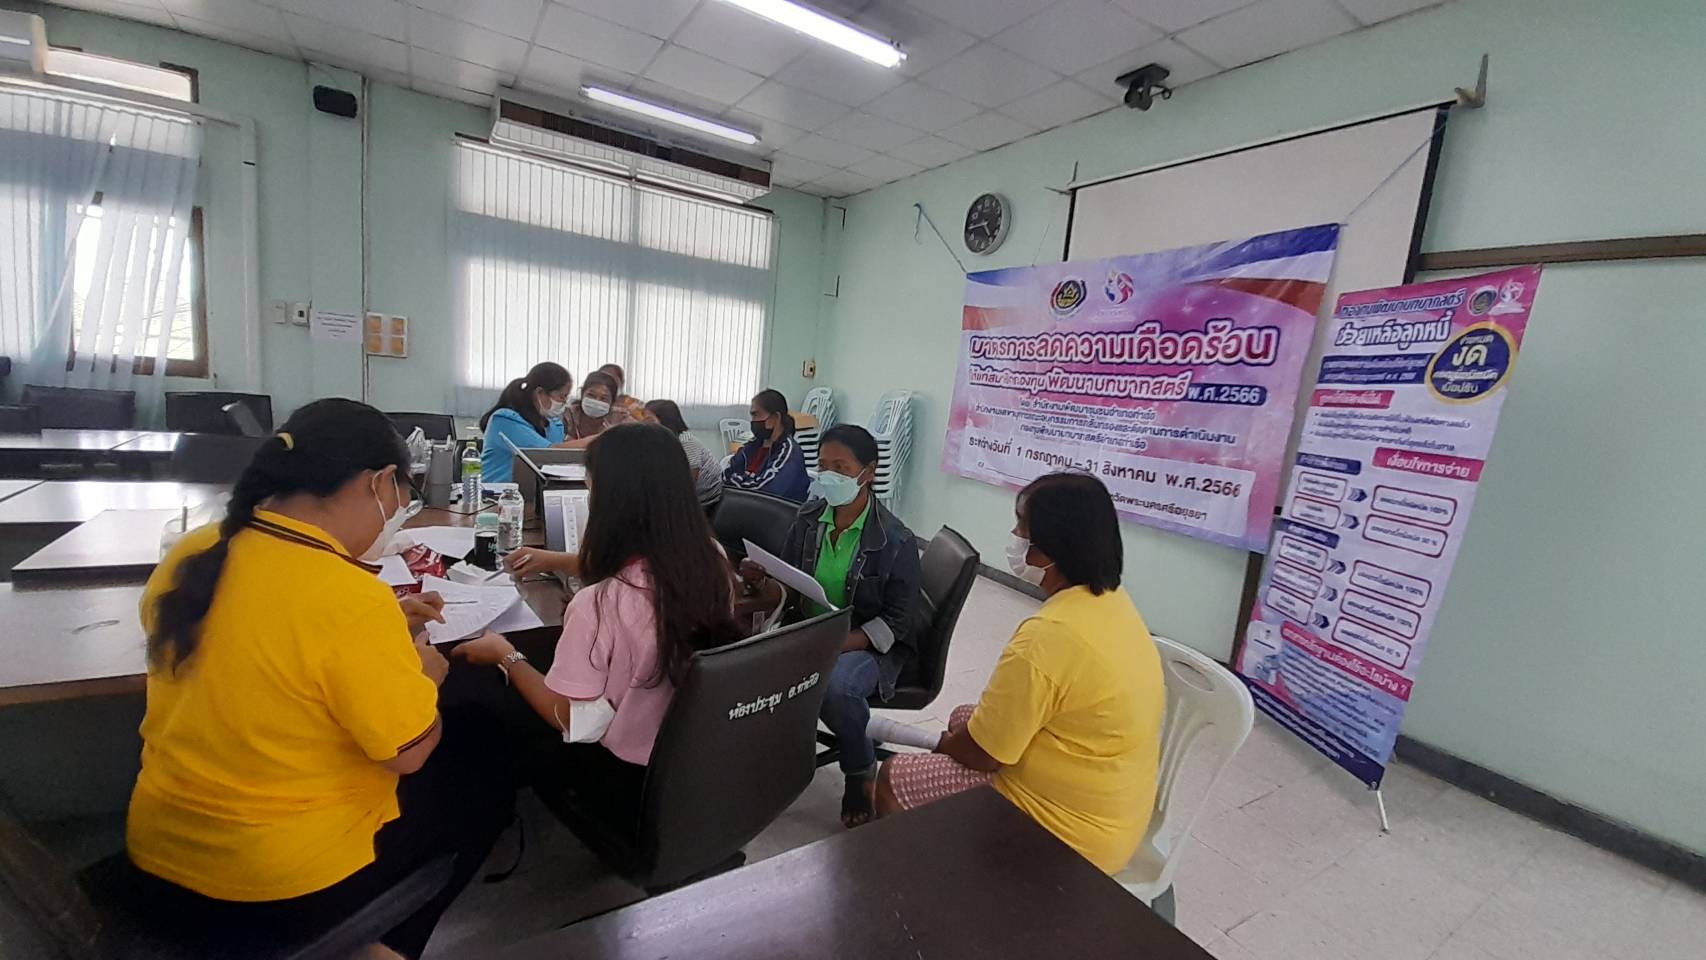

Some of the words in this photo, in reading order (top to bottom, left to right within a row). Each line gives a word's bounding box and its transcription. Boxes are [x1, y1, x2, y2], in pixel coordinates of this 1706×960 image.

[970, 321, 1276, 362] มาตรการลดความเดือดร้อน
[1335, 311, 1455, 350] ช่วยเหลือลูกหนี้
[1452, 344, 1488, 367] งด
[1188, 385, 1260, 404] พ.ศ.2566
[969, 436, 1013, 455] ระหว่างวันที่
[1016, 446, 1022, 457] 1
[1025, 448, 1073, 467] กรกฎาคม
[1086, 459, 1098, 473] 31
[1102, 460, 1156, 483] สิงหาคม
[1166, 472, 1242, 498] พ.ศ.2566
[728, 691, 783, 720] ห้องประชุม
